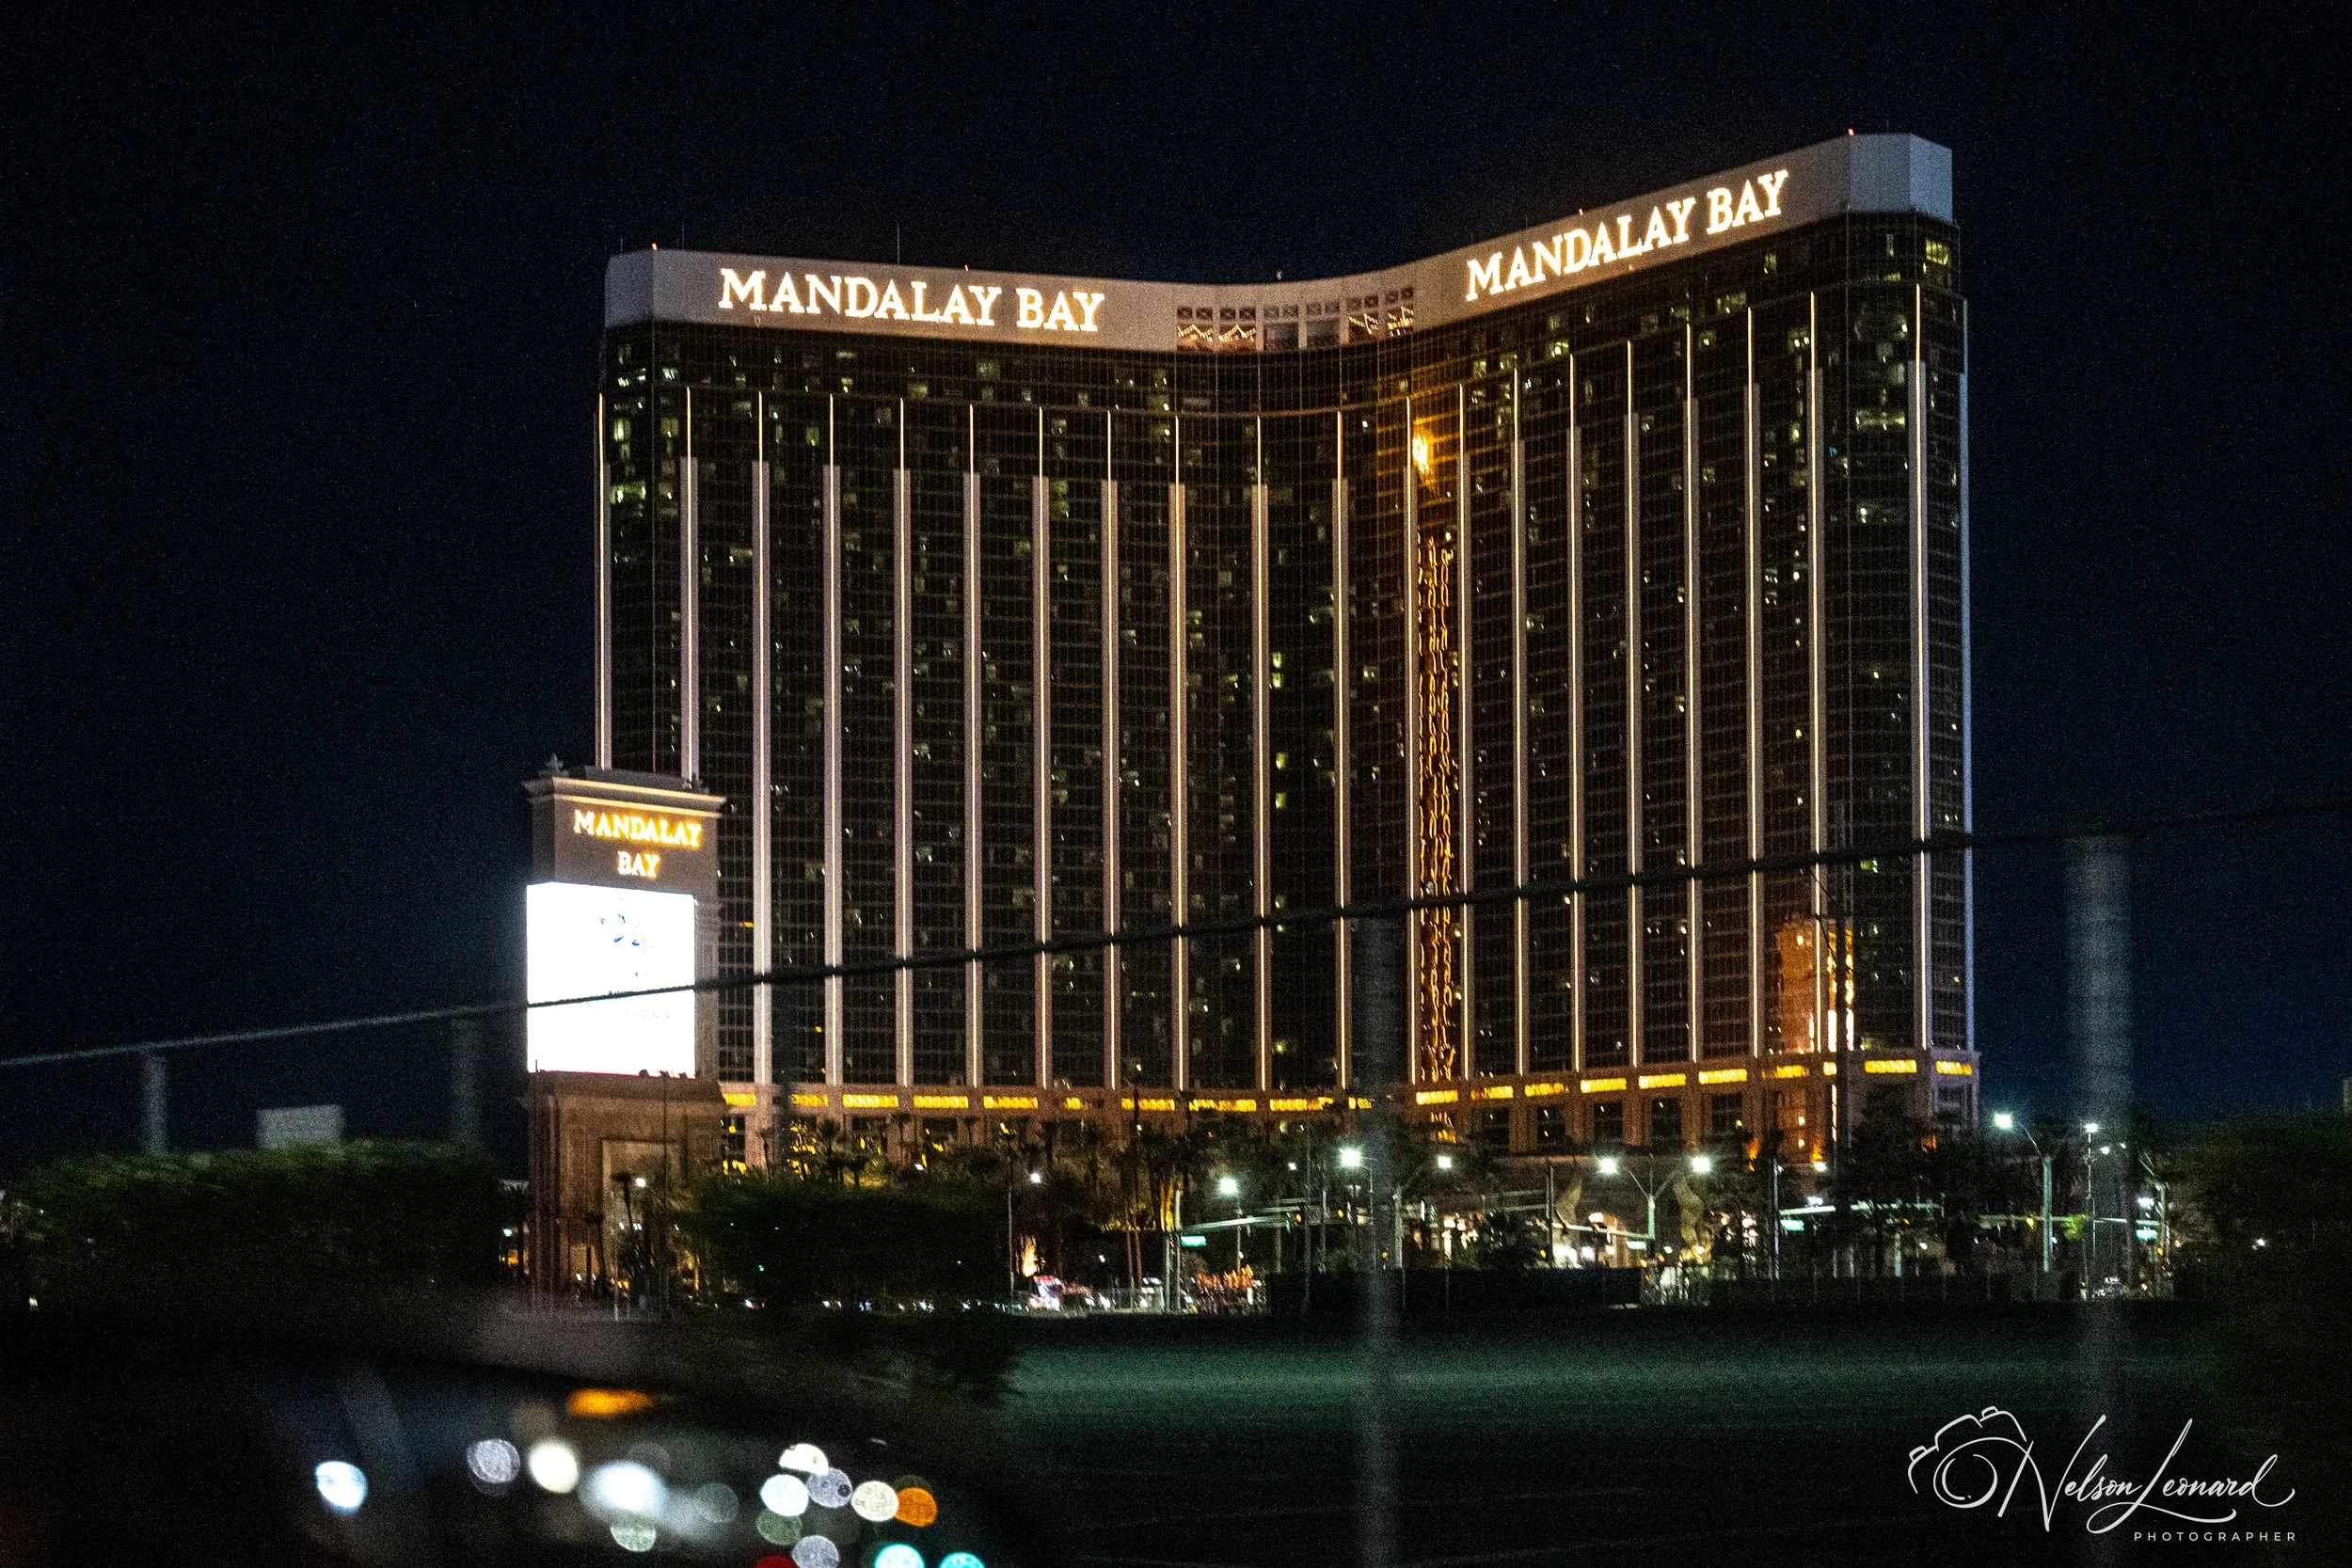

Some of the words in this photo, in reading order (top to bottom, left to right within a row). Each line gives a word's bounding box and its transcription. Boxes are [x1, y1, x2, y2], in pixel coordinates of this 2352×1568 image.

[1466, 197, 1696, 301] MANDALAY
[1706, 169, 1788, 235] BAY
[718, 268, 1002, 326] MANDALAY
[1015, 288, 1105, 332] BAY
[573, 810, 703, 847] MANDALAY
[617, 851, 660, 879] BAY
